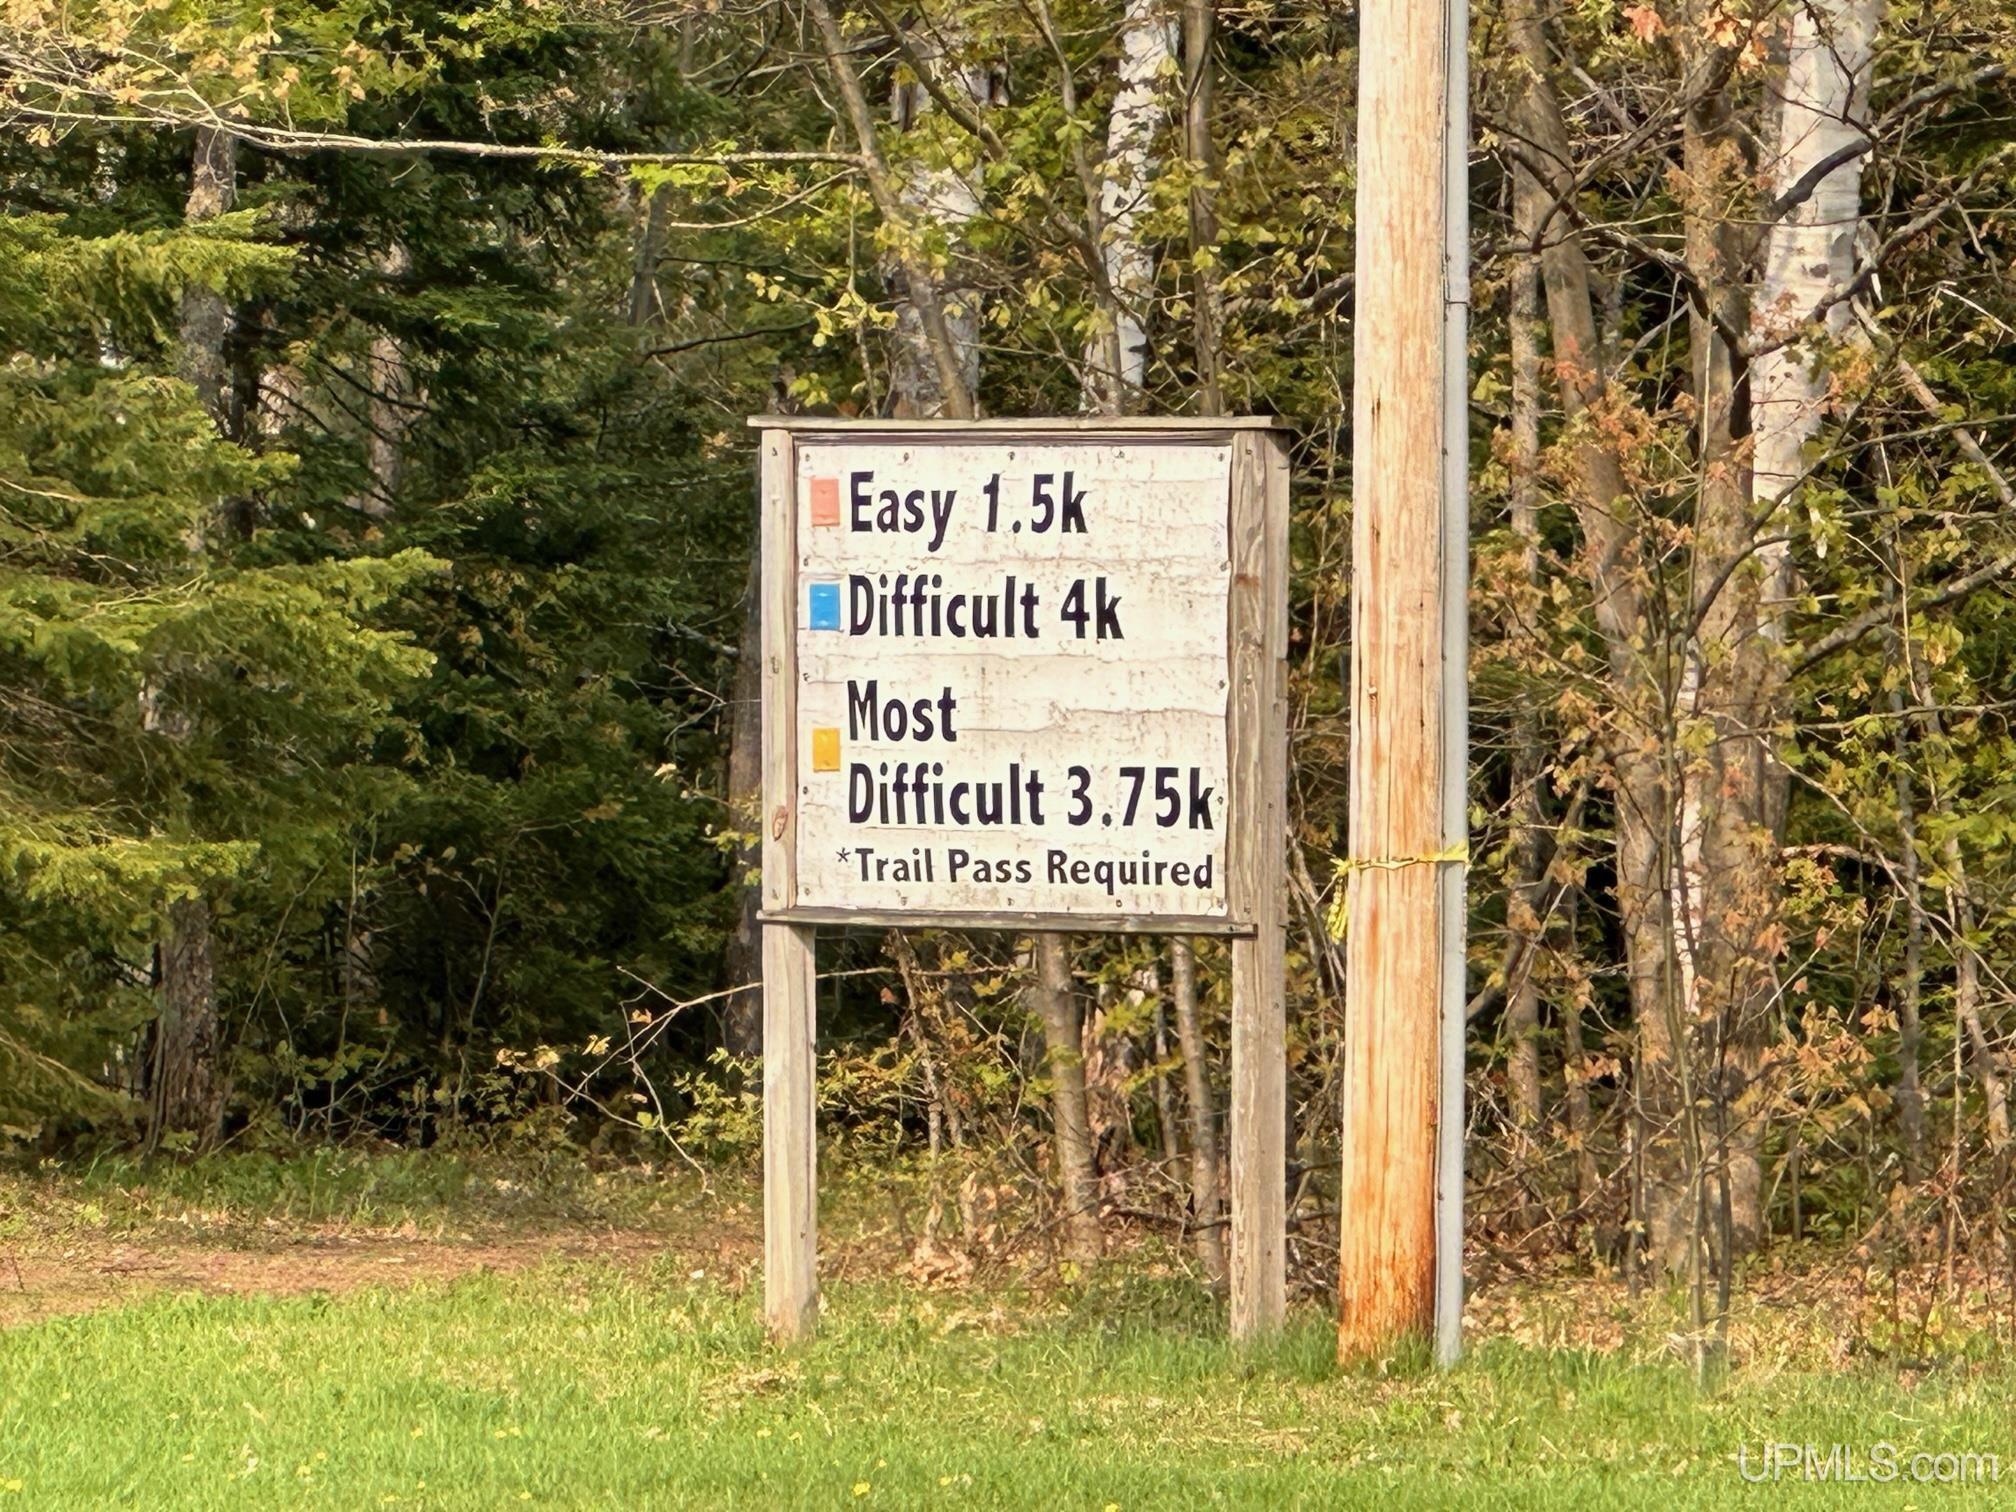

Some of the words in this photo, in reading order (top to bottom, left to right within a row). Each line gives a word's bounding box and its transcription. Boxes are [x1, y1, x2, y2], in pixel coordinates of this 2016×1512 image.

[850, 471, 957, 553] Easy
[983, 472, 1088, 534] 1.5k
[849, 574, 1039, 639] Difficult
[1060, 577, 1124, 640] 4k
[847, 680, 957, 742] Most
[849, 762, 1045, 826] Difficult
[1067, 765, 1215, 830] 3.75k
[948, 849, 1032, 884] Pass
[1047, 849, 1213, 896] Required
